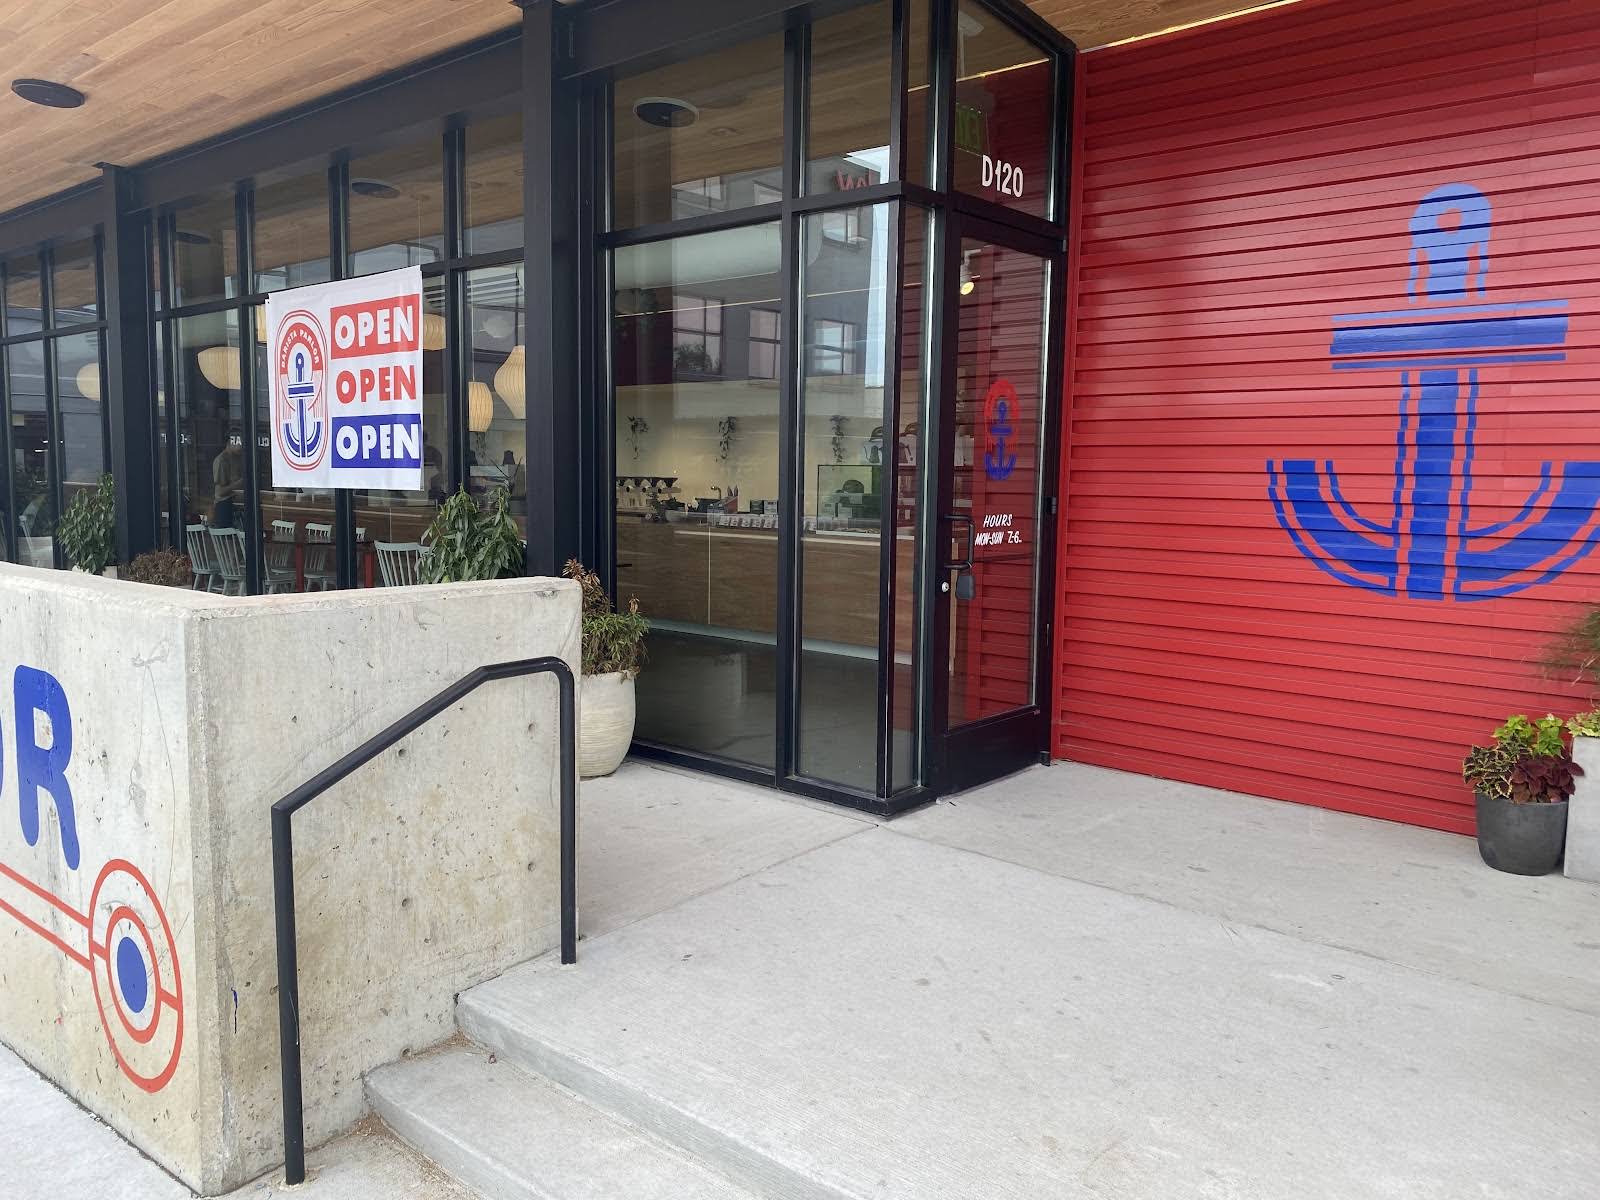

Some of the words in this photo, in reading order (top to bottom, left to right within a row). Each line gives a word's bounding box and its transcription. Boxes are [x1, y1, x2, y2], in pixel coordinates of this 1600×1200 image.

[982, 154, 1024, 198] D120
[334, 304, 414, 350] OPEN
[281, 332, 299, 369] BARISTA
[299, 329, 320, 365] PARLOR
[335, 365, 417, 404] OPEN
[335, 423, 420, 460] OPEN
[974, 531, 1005, 547] MON-SUN
[982, 514, 1013, 528] HOURS
